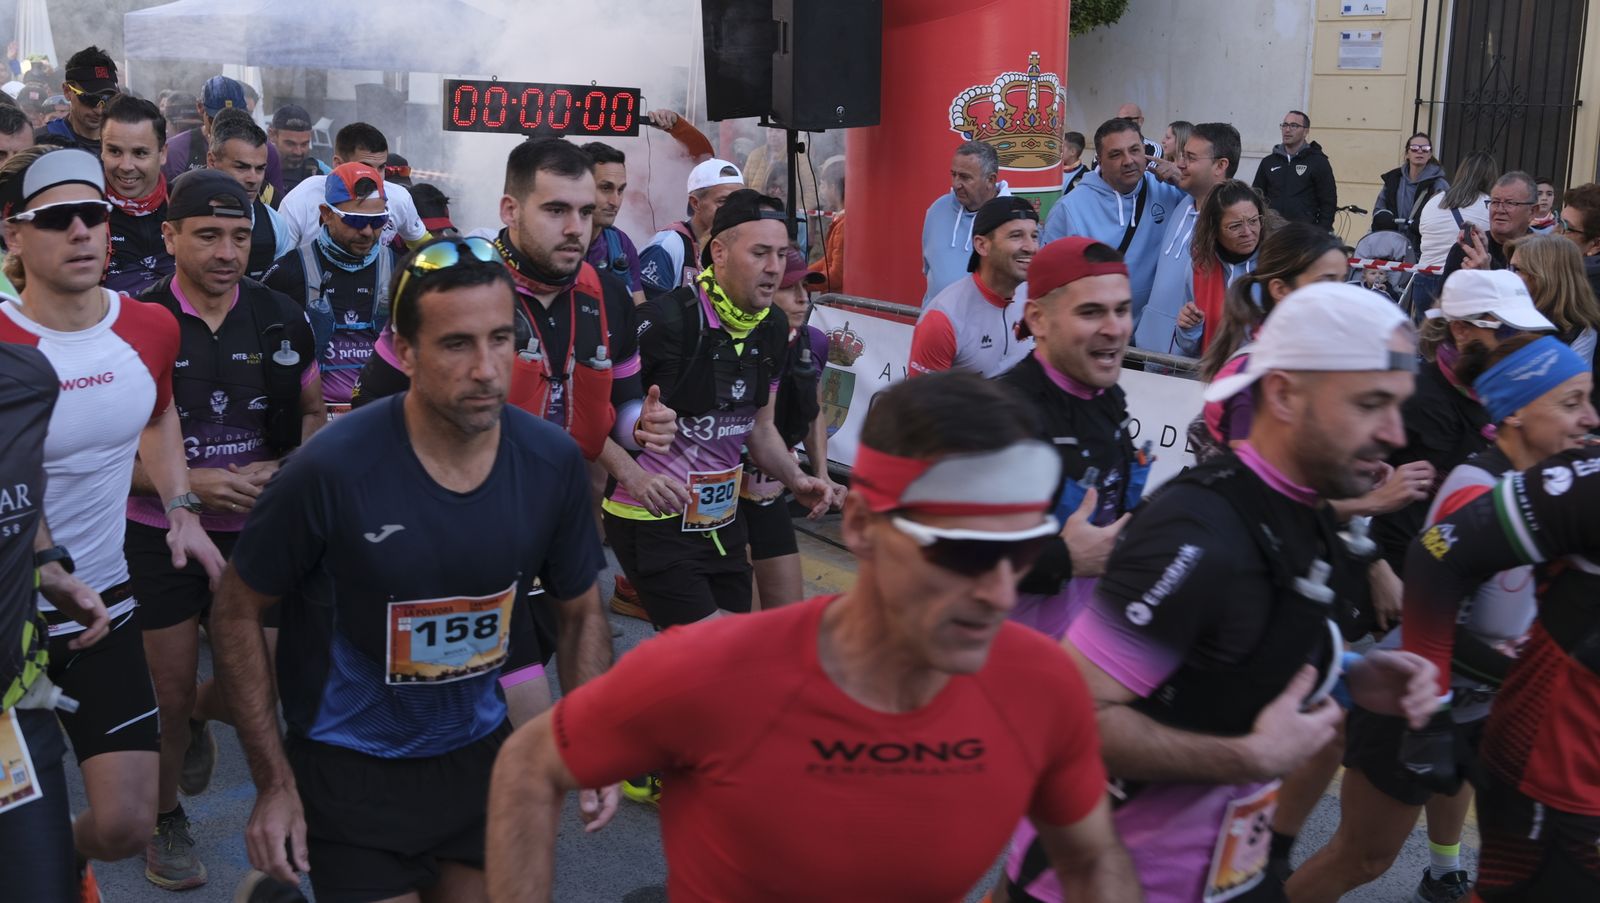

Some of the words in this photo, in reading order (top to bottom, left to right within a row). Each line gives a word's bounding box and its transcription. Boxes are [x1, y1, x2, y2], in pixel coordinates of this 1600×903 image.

[59, 372, 114, 391] WONG
[701, 482, 735, 504] 320
[415, 613, 499, 647] 158
[811, 738, 985, 763] WONG
